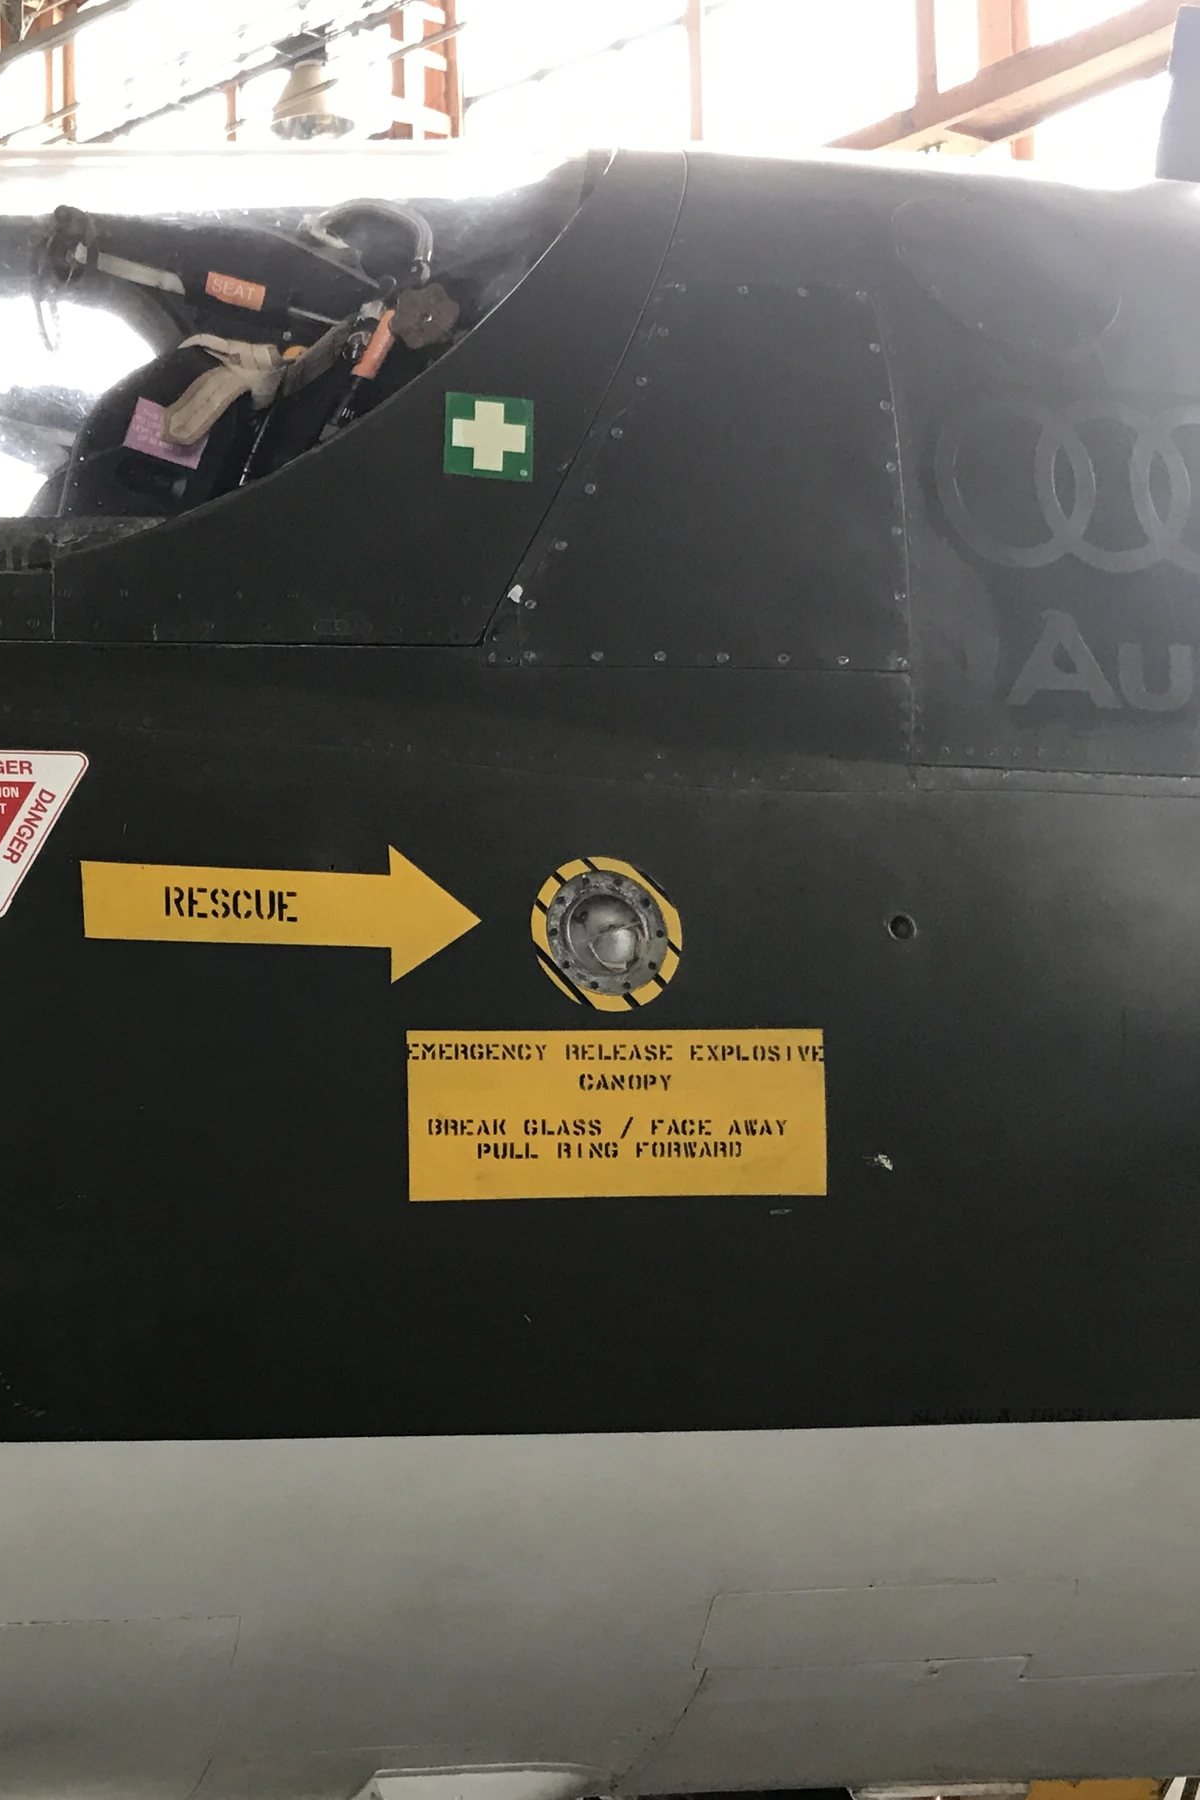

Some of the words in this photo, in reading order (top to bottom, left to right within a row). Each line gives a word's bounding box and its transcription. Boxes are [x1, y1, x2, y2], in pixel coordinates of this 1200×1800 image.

[211, 279, 255, 301] SEAT
[2, 788, 57, 865] DANGER
[164, 886, 298, 923] RESCUE
[406, 1042, 547, 1061] EMERGENCY
[565, 1043, 673, 1062] RELEASE
[690, 1044, 824, 1062] EXPLOSIVE
[578, 1073, 672, 1091] CANOPY
[427, 1118, 506, 1136] BREAK
[523, 1118, 602, 1137] GLASS
[620, 1117, 634, 1140] /
[650, 1118, 712, 1136] FACE
[728, 1118, 787, 1137] AWAY
[477, 1142, 539, 1160] PULL
[557, 1141, 619, 1159] RING
[635, 1140, 742, 1159] FORWARD
